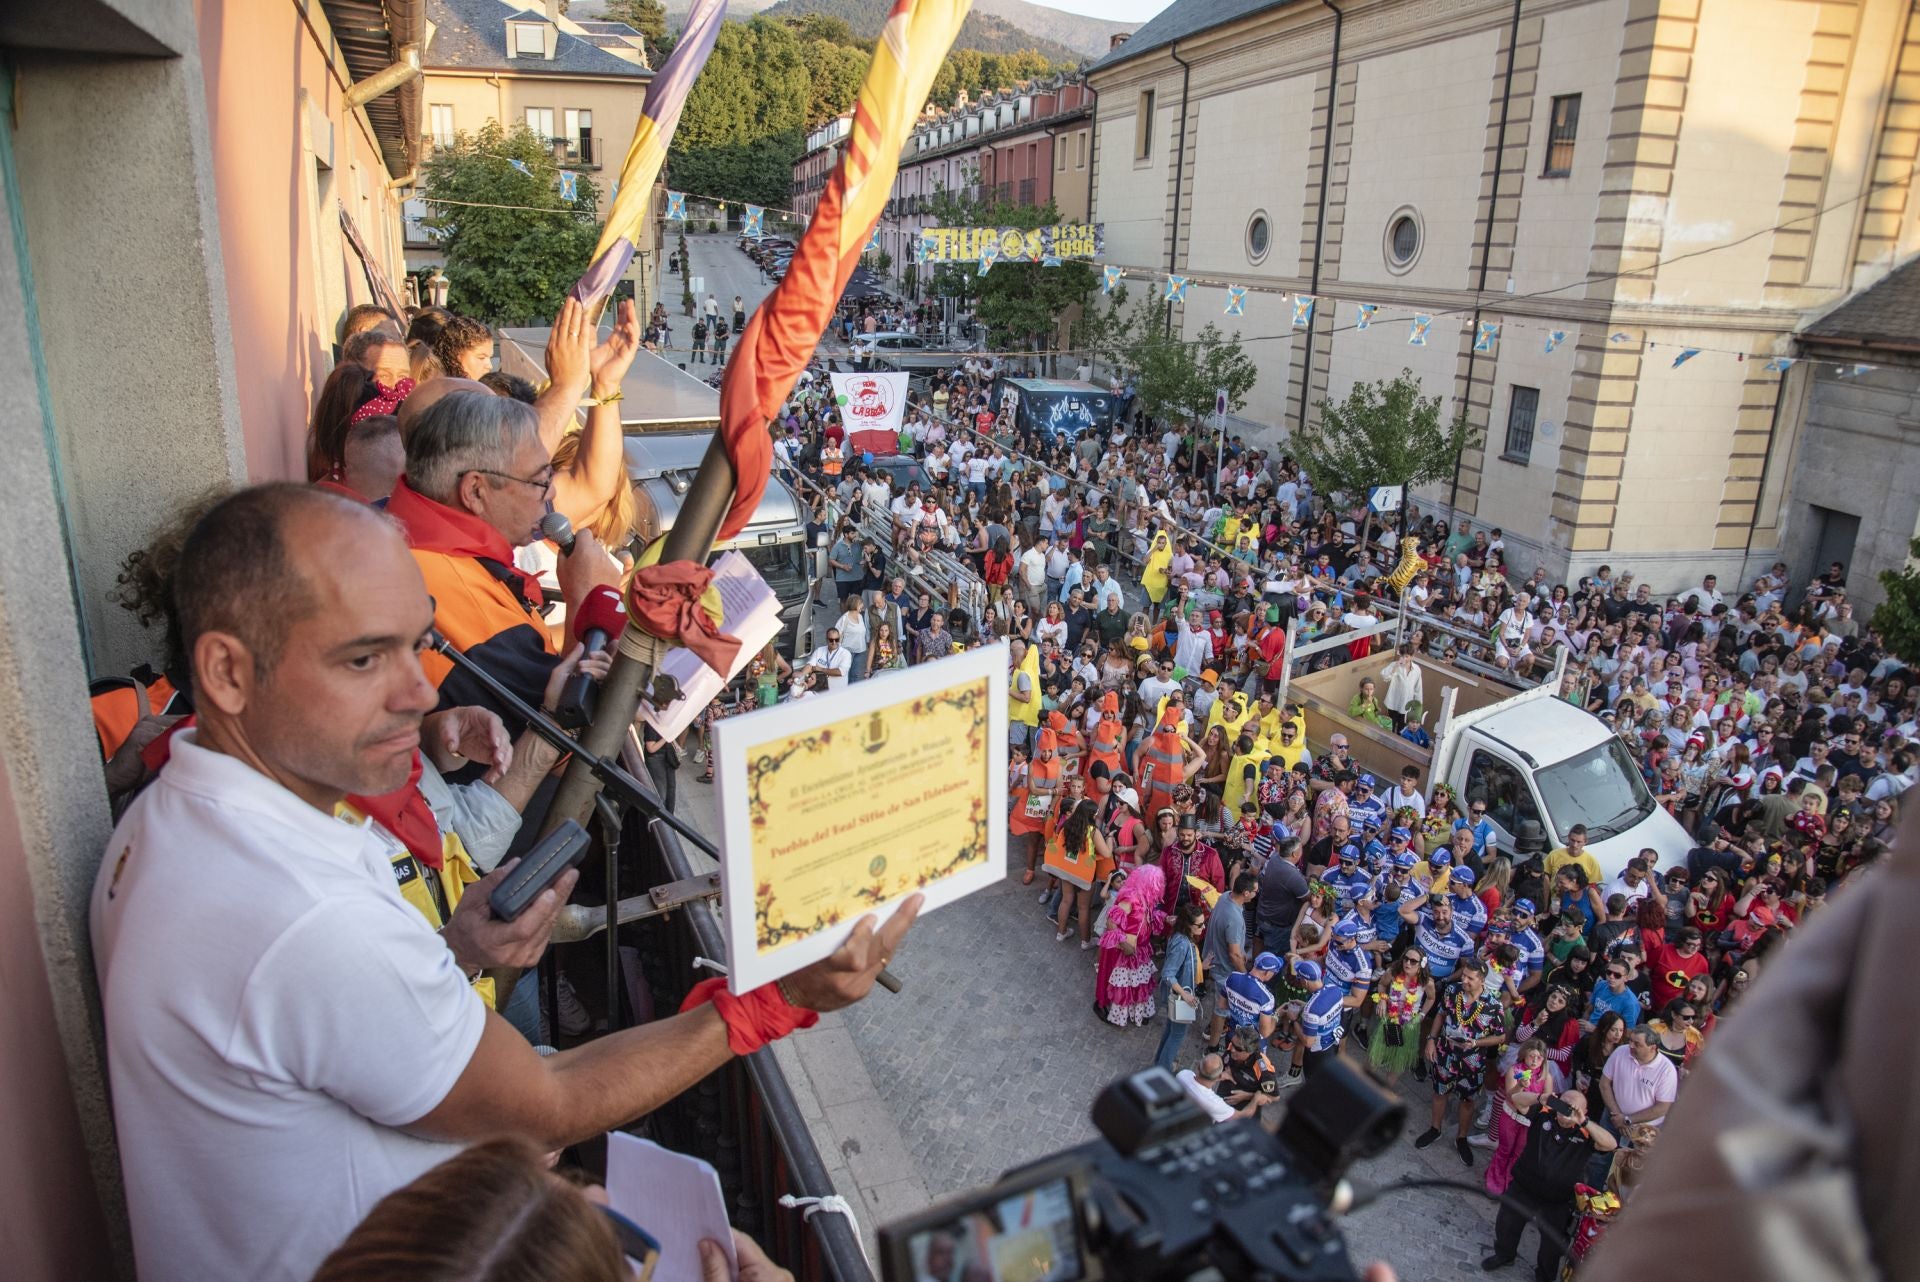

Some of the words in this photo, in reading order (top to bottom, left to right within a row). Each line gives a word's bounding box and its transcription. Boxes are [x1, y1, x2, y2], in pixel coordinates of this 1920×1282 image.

[1052, 224, 1095, 239] DESDE
[1053, 239, 1096, 257] 1996
[771, 838, 810, 859] Pueblo
[859, 810, 885, 825] Sitio
[887, 803, 900, 816] de
[1422, 931, 1455, 956] Reynolds
